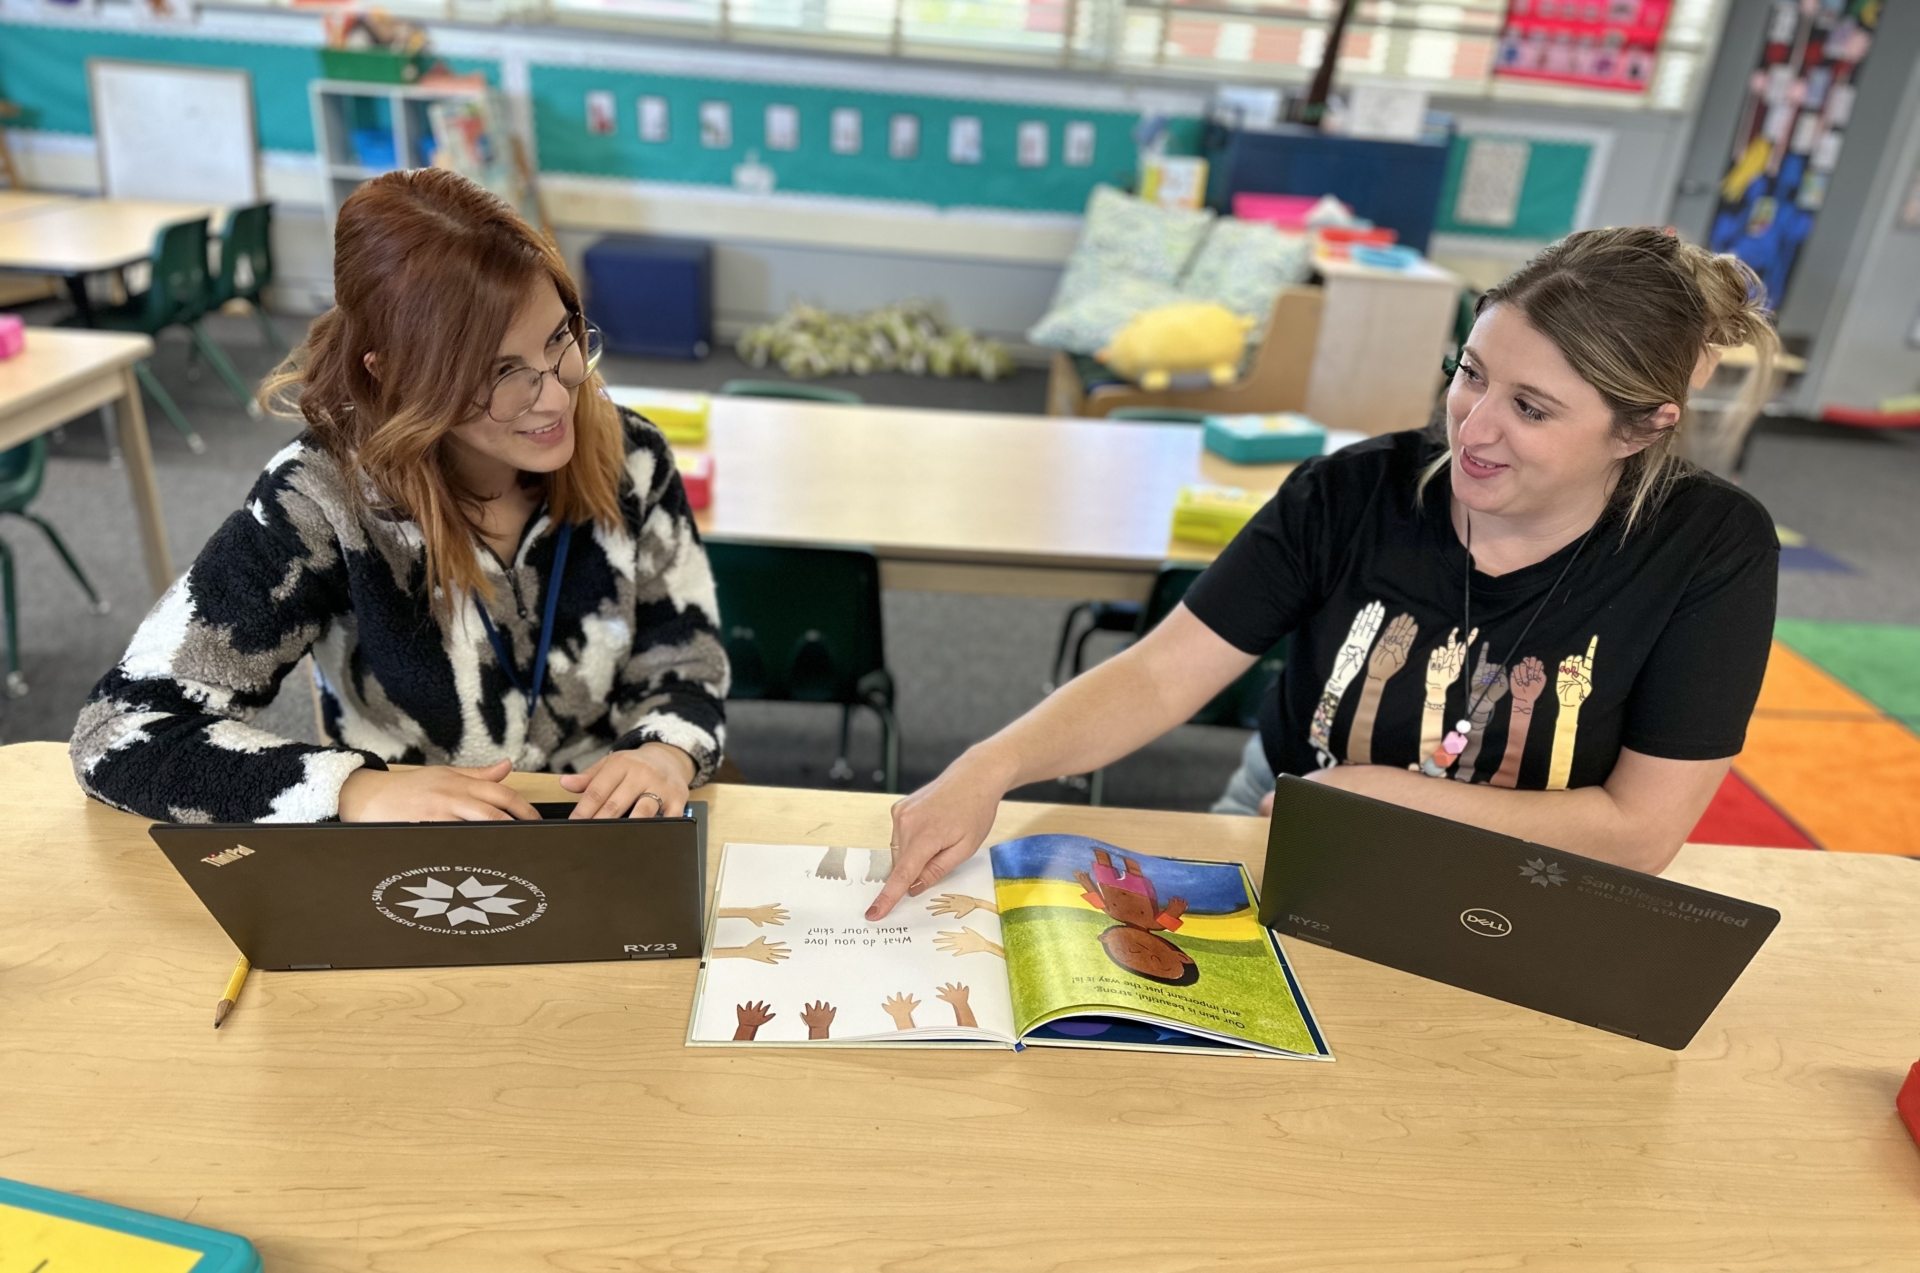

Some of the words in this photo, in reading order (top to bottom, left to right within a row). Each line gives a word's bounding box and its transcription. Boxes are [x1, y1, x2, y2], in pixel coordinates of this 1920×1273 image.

[401, 866, 451, 877] UNIFIED
[454, 866, 507, 879] SCHOOL
[375, 874, 402, 890] DIEGO
[508, 875, 546, 899] DISTRICT
[371, 889, 383, 901] SAN
[1577, 886, 1631, 905] SCHOOL
[1581, 874, 1615, 891] San
[1678, 901, 1750, 928] Unified
[1288, 914, 1331, 932] RY22
[1466, 914, 1506, 932] DELL
[418, 925, 467, 935] SCHOOL
[470, 924, 516, 935] UNIFIED
[807, 927, 834, 936] skin?
[841, 927, 869, 935] your
[876, 926, 909, 936] about
[804, 938, 828, 947] love
[834, 938, 856, 946] you
[862, 938, 876, 947] do
[884, 936, 912, 946] What
[623, 943, 678, 953] RY23
[1098, 975, 1121, 985] way
[1124, 980, 1141, 990] the
[1145, 985, 1163, 996] just
[1135, 991, 1185, 1012] beautiful,
[1167, 991, 1219, 1011] important
[1188, 1007, 1196, 1015] is
[1199, 1010, 1220, 1021] skin
[1222, 1007, 1241, 1017] and
[1223, 1018, 1245, 1029] Our
